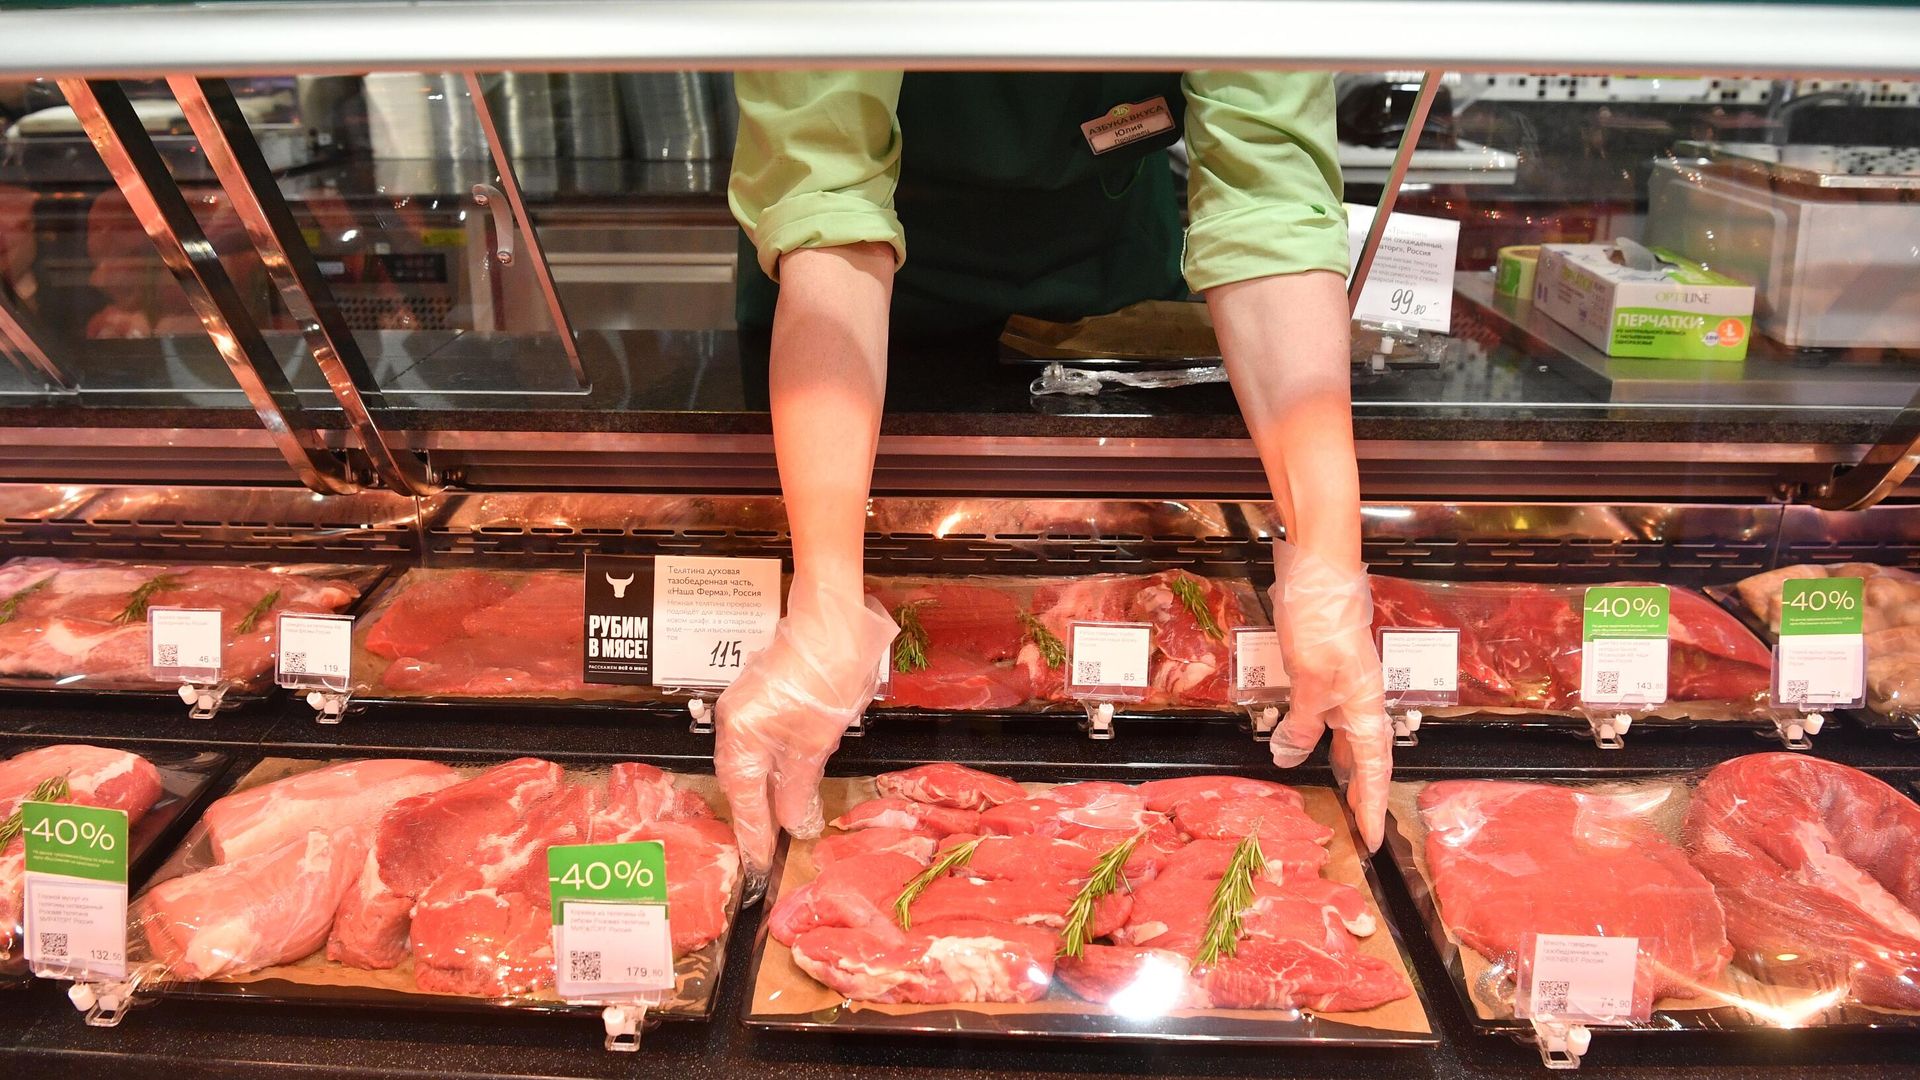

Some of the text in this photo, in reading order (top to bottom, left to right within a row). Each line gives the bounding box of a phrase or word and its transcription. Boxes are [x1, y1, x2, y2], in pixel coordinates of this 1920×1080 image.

[1089, 105, 1164, 135] АЗБУКА ВКУСА
[1114, 123, 1144, 138] Юлия
[1406, 246, 1432, 256] Россия
[1655, 291, 1711, 304] OPTILINE
[1617, 313, 1703, 329] ПЕРЧАТКИ
[667, 565, 741, 577] Телятина духовая
[667, 577, 754, 587] тазобедренная часть,
[667, 588, 762, 598] «Наша Ферма», Россия
[1782, 590, 1855, 611] -40%
[1584, 597, 1661, 617] -40%
[588, 615, 648, 639] РУБИМ
[588, 638, 648, 659] В МЯСЕ!
[22, 817, 115, 850] -40%
[549, 859, 655, 891] -40%
